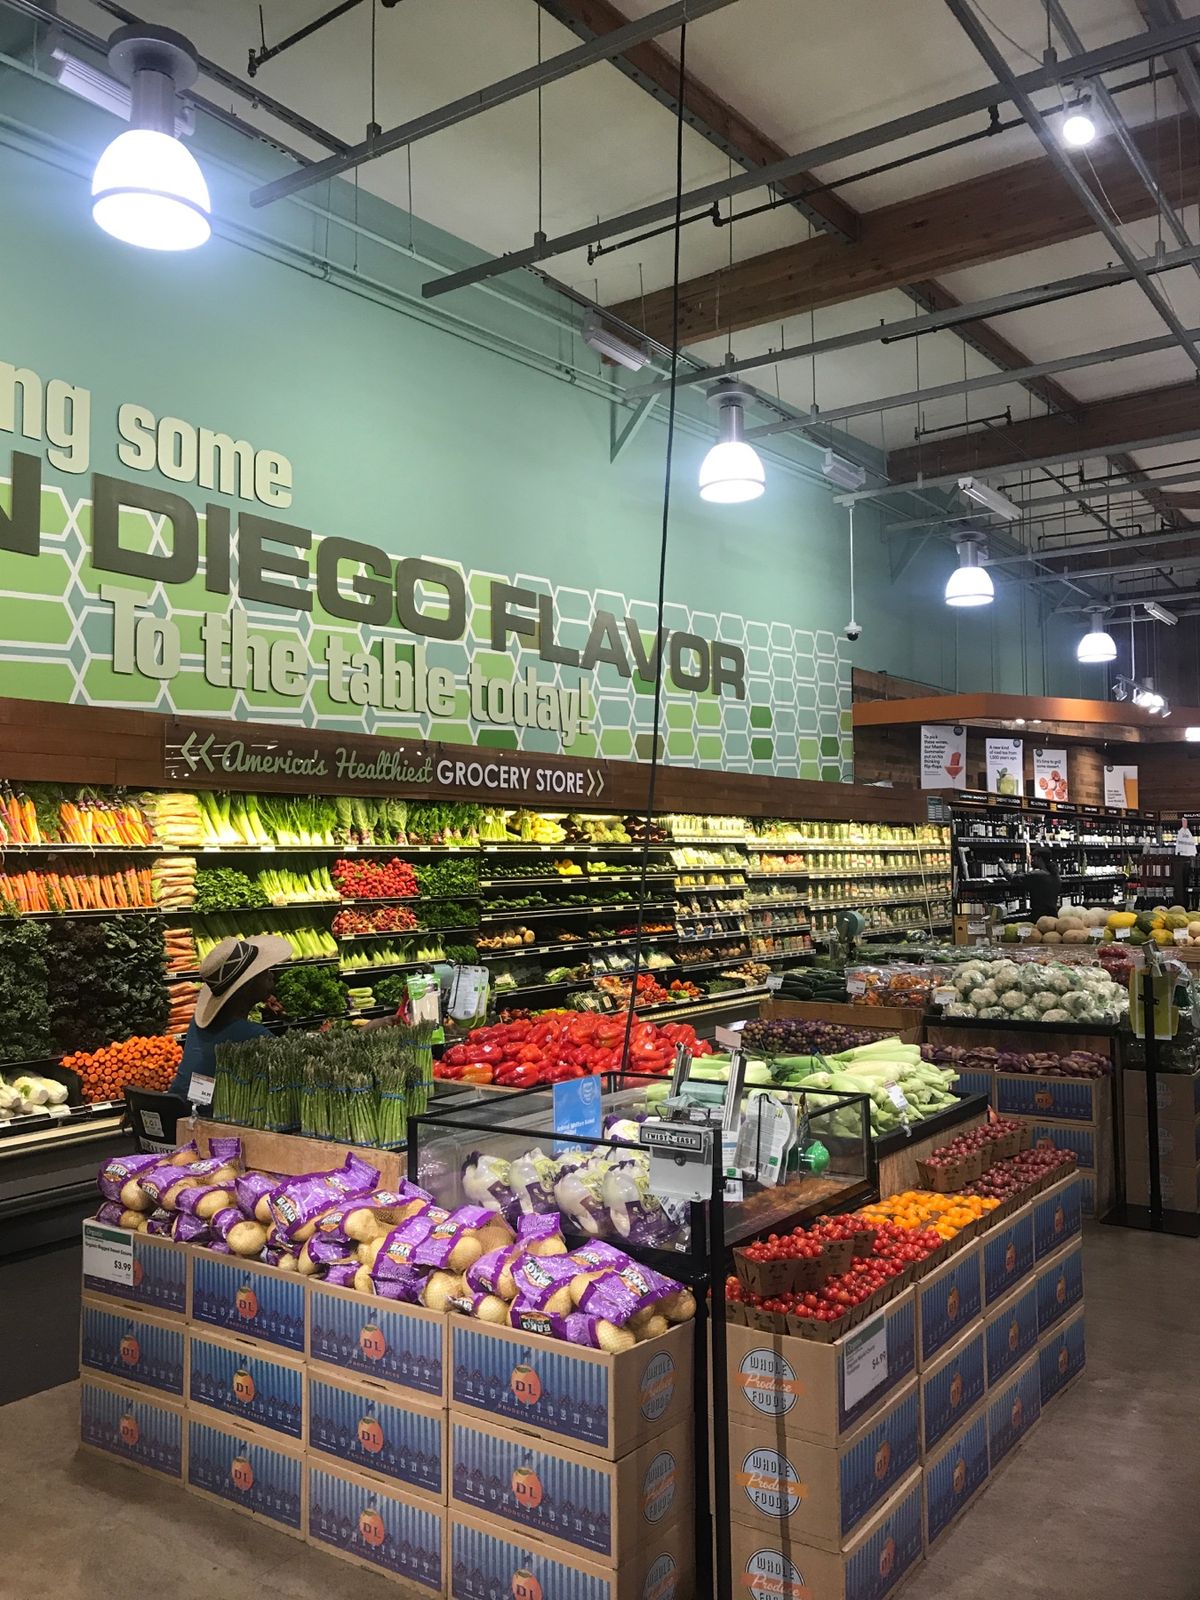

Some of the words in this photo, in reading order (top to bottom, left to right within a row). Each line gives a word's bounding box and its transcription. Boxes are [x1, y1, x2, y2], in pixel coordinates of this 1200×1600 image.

[117, 403, 293, 509] some
[92, 472, 465, 641] DIEGO
[491, 580, 745, 700] FLAVOR
[100, 584, 181, 680] To
[201, 608, 308, 696] the
[325, 634, 456, 717] table
[468, 662, 590, 748] today!
[221, 740, 329, 777] America's
[336, 748, 434, 785] Healthiest
[437, 759, 531, 790] GROCERY
[536, 769, 584, 795] STORE
[276, 1197, 296, 1222] BAKO
[114, 1260, 132, 1272] $3.99
[524, 1263, 552, 1288] BAKO
[620, 1268, 649, 1293] BAKO
[239, 1299, 253, 1312] DL
[522, 1321, 551, 1333] BAKO
[122, 1347, 136, 1358] DL
[364, 1338, 382, 1352] DL
[750, 1356, 787, 1376] WHOLE
[236, 1382, 252, 1396] DL
[515, 1379, 537, 1396] DL
[744, 1371, 793, 1392] Produce
[752, 1391, 787, 1409] FOODS
[361, 1430, 381, 1446] DL
[752, 1456, 790, 1477] WHOLE
[234, 1470, 250, 1483] DL
[747, 1471, 795, 1494] Produce
[516, 1483, 538, 1499] DL
[754, 1491, 789, 1512] FOODS
[363, 1522, 382, 1539] DL
[756, 1556, 795, 1579] WHOLE
[516, 1585, 538, 1600] DL
